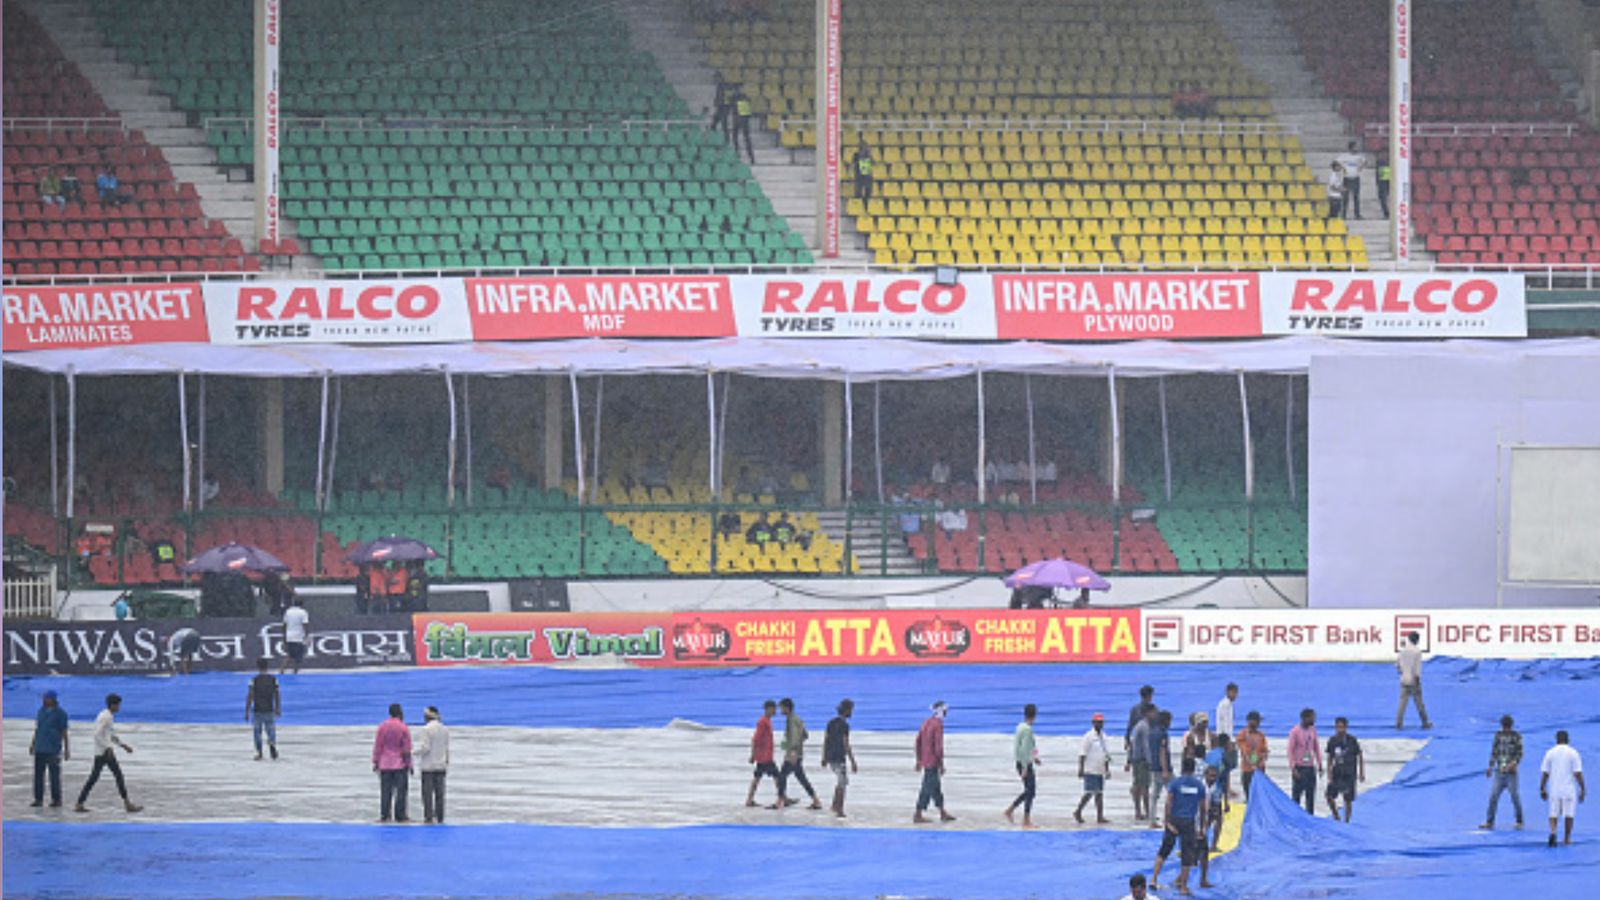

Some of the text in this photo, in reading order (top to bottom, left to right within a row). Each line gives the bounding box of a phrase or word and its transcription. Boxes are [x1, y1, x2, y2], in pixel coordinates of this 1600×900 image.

[1397, 3, 1407, 59] RALCO
[267, 92, 276, 149] RALCO
[267, 195, 276, 240] ALCO
[236, 284, 441, 321] RALCO
[475, 281, 721, 314] INFRA.MARKET
[761, 279, 967, 315] RALCO
[1002, 279, 1249, 312] INFRA.MARKET
[1290, 279, 1498, 313] RALCO
[26, 325, 133, 343] LAMINATES
[235, 323, 311, 339] TYRES
[583, 314, 626, 331] MDF
[761, 317, 835, 332] TYRES
[1084, 314, 1174, 332] PLYWOOD
[1288, 316, 1364, 330] TYRES
[735, 620, 796, 637] CHAKKI
[800, 617, 897, 656] ATTA
[975, 619, 1036, 635] CHAKKI
[1040, 616, 1137, 654] ATTA
[1189, 624, 1382, 645] IDFC FIRST Bank
[1437, 625, 1491, 643] IDFC
[1500, 625, 1566, 643] FIRST
[5, 628, 158, 664] NIWAS
[544, 627, 665, 659] Vimal
[745, 639, 796, 656] FRESH
[985, 638, 1036, 654] FRESH
